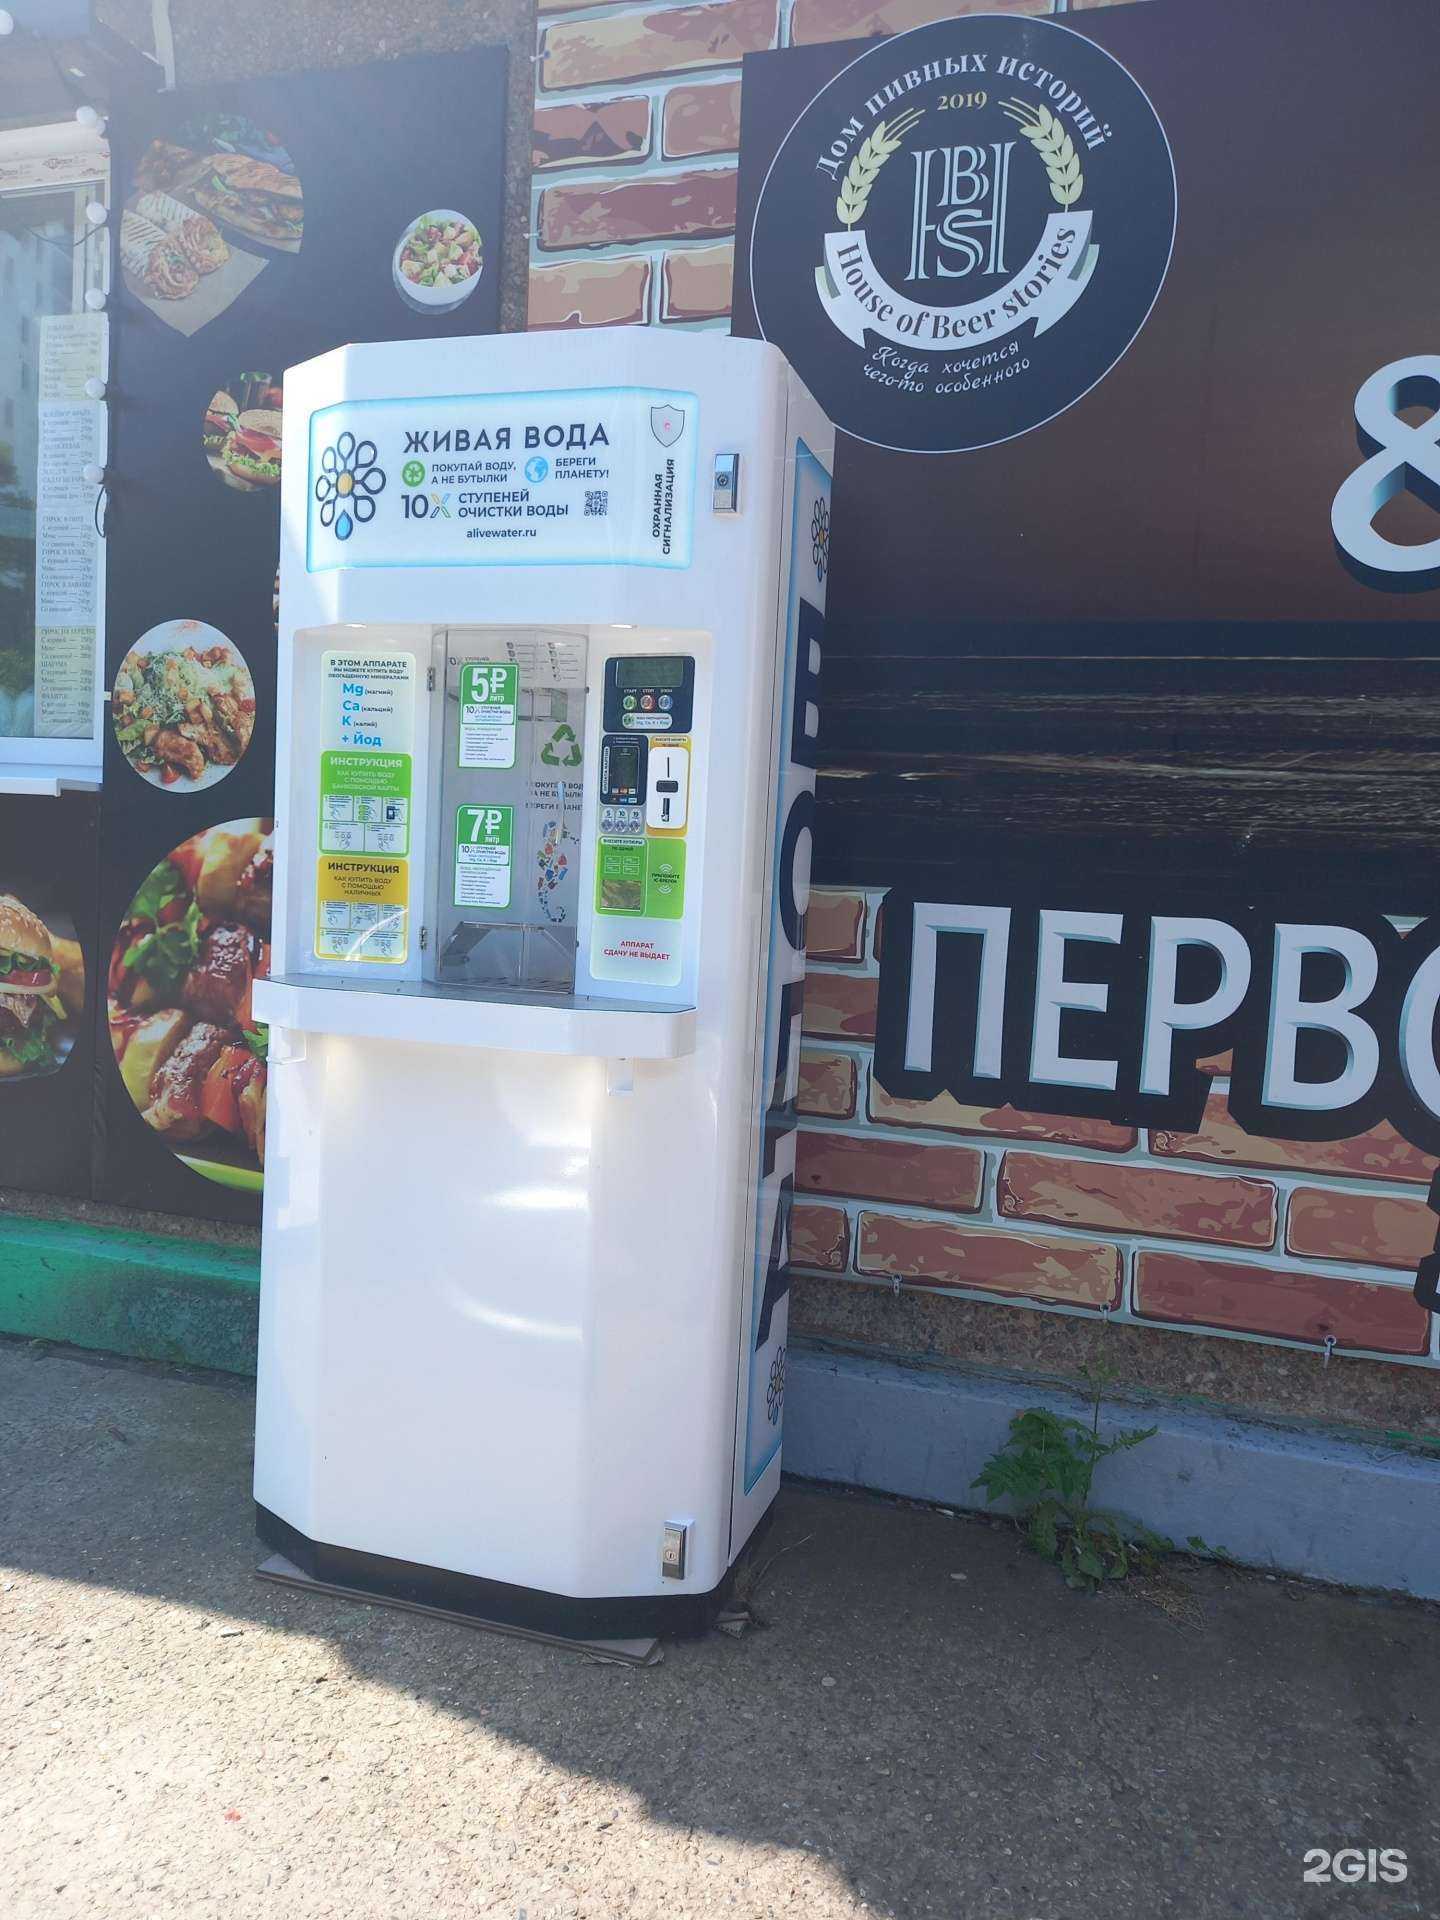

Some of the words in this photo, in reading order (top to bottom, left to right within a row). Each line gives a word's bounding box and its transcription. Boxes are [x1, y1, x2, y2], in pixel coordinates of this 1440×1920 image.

[937, 91, 988, 111] 2019
[816, 116, 865, 181] Дом
[864, 53, 988, 117] пивных
[997, 55, 1112, 151] историй
[837, 243, 894, 322] House
[896, 309, 932, 338] of
[931, 310, 998, 340] Beer
[1004, 227, 1077, 321] stories
[872, 345, 930, 379] Когда
[942, 340, 1019, 375] хочется
[863, 363, 925, 393] чего-то
[935, 357, 1031, 394] особенного
[403, 427, 511, 453] ЖИВАЯ
[524, 422, 610, 450] ВОДА
[432, 461, 482, 473] ПОКУПАЙ
[485, 461, 517, 471] ВОДУ,
[555, 457, 596, 467] БЕРЕГИ
[431, 476, 439, 485] А
[441, 475, 455, 485] НЕ
[457, 474, 508, 484] БУТЫЛКИ
[555, 469, 609, 480] ПЛАНЕТУ!
[458, 489, 530, 504] СТУПЕНЕЙ
[458, 505, 522, 518] ОЧИСТКИ
[526, 504, 569, 517] ВОДЫ
[652, 473, 663, 538] ОХРАННАЯ
[662, 459, 675, 555] СИГНАЛИЗАЦИЯ
[466, 528, 537, 539] alivewater.ru
[342, 683, 364, 696] Mg
[342, 700, 360, 711] Ca
[353, 732, 382, 747] Йод
[330, 757, 402, 768] ИНСТРУКЦИЯ
[328, 862, 400, 874] ИНСТРУКЦИЯ
[620, 941, 655, 949] АППАРАТ
[640, 952, 671, 960] ВЫДАЕТ
